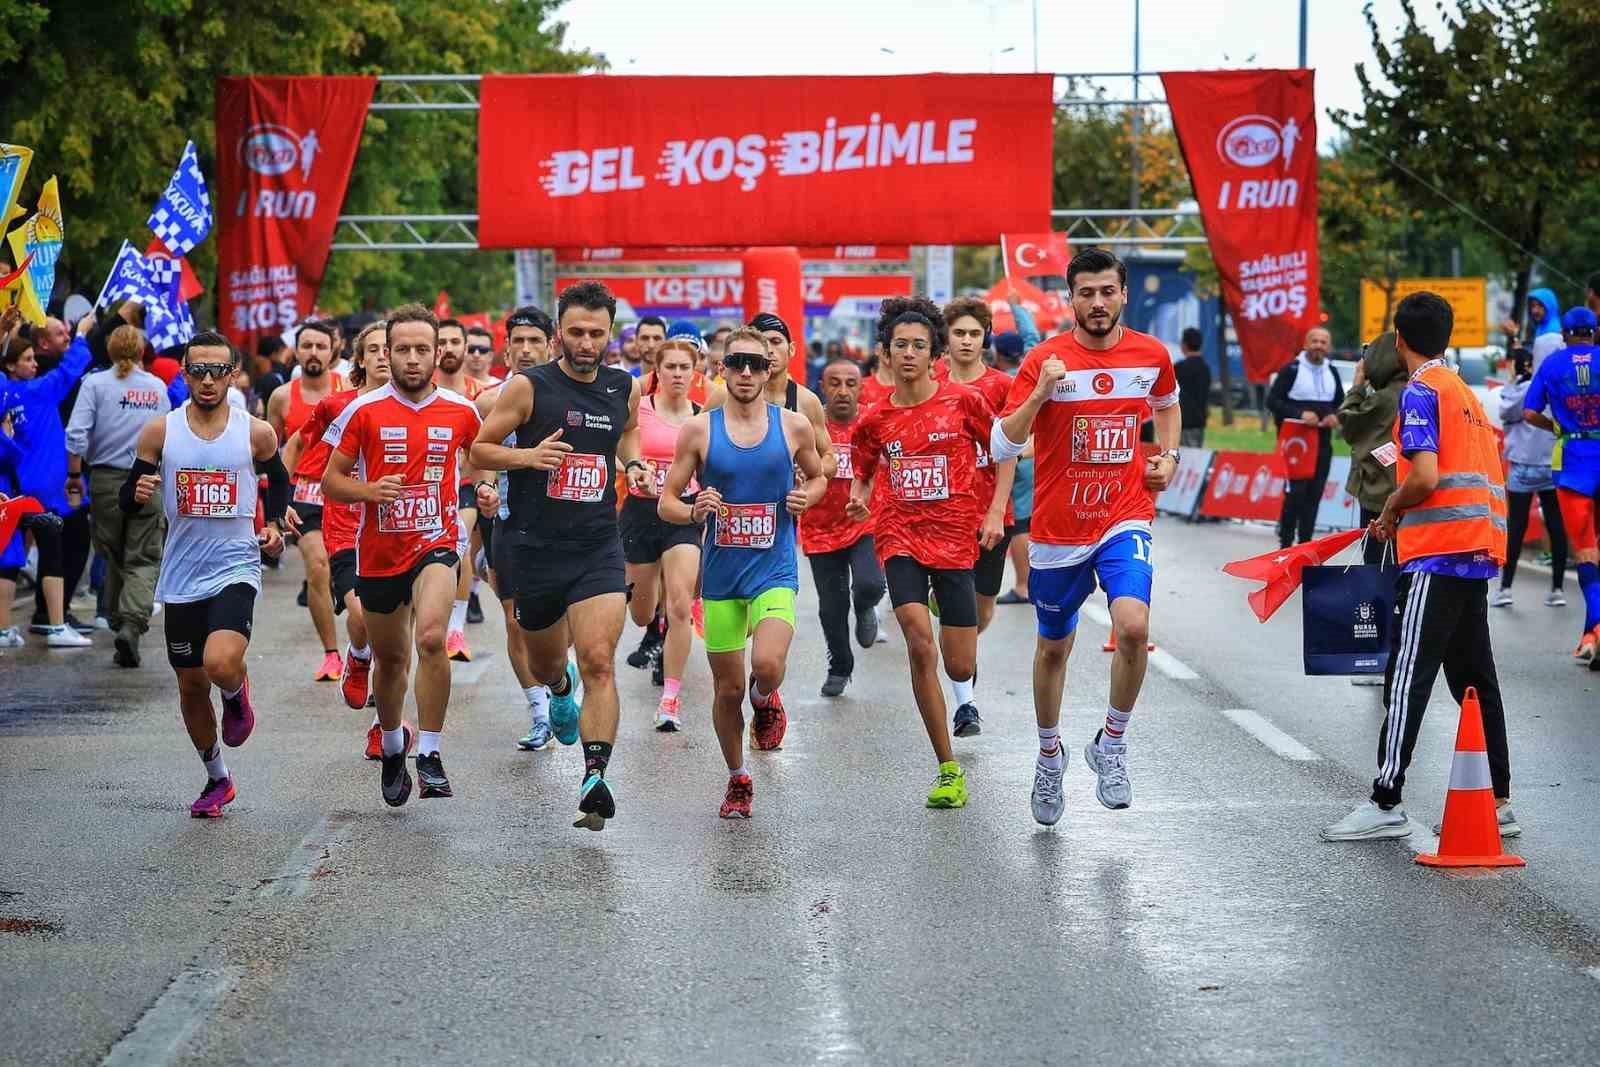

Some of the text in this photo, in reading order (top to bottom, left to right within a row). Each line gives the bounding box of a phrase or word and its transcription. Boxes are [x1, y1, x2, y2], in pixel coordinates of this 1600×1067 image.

[540, 112, 977, 198] GEL KOŞ BİZİMLE
[255, 189, 316, 219] RUN
[1238, 179, 1298, 209] RUN
[1240, 284, 1308, 320] KOŞ
[128, 390, 159, 401] PLUS
[1094, 428, 1128, 449] 1171
[566, 466, 601, 488] 1150
[902, 467, 943, 488] 2975
[194, 483, 230, 504] 1166
[581, 489, 601, 498] SPX
[922, 488, 944, 497] SPX
[211, 505, 233, 513] SPX
[394, 496, 437, 518] 3730
[416, 517, 438, 527] SPX
[730, 515, 773, 535] 3588
